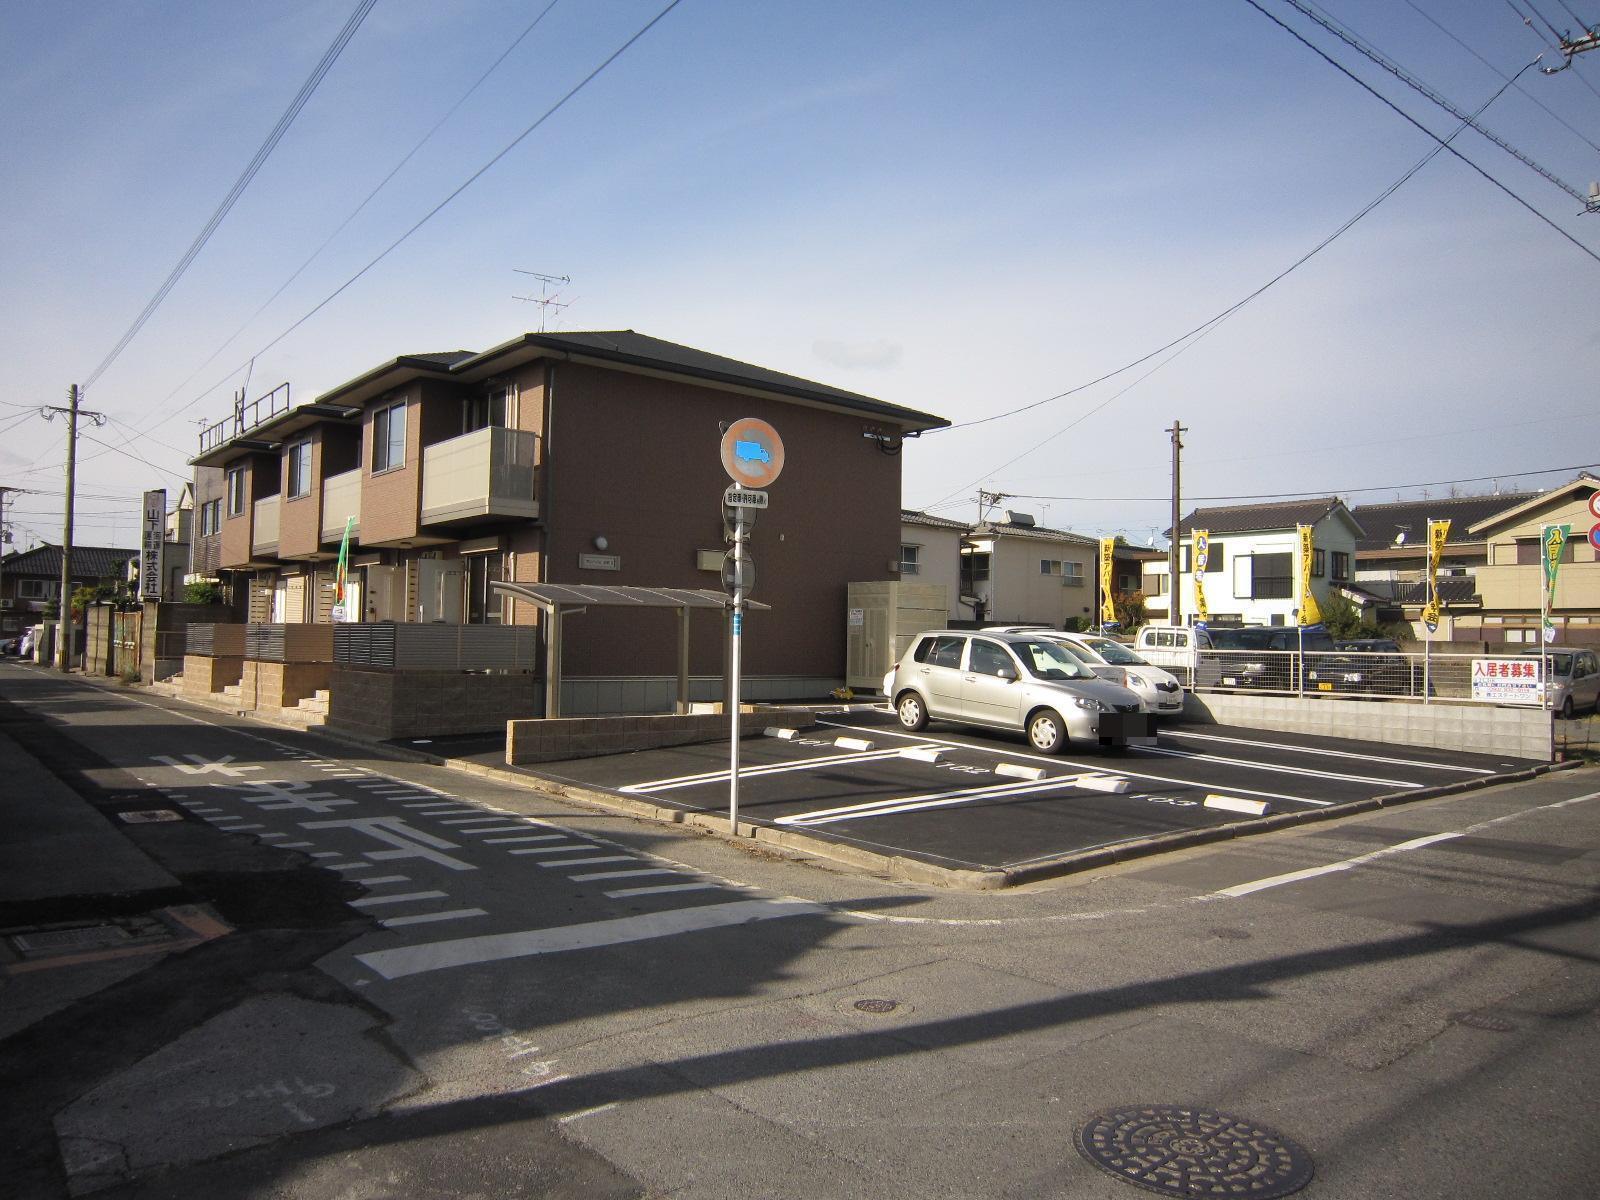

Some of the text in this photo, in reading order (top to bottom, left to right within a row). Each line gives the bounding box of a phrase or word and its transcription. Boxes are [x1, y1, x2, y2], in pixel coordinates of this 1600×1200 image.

[144, 550, 158, 594] 株式会社
[1475, 662, 1535, 678] 入居者募集
[935, 761, 990, 774] 102
[1128, 794, 1198, 806] 103
